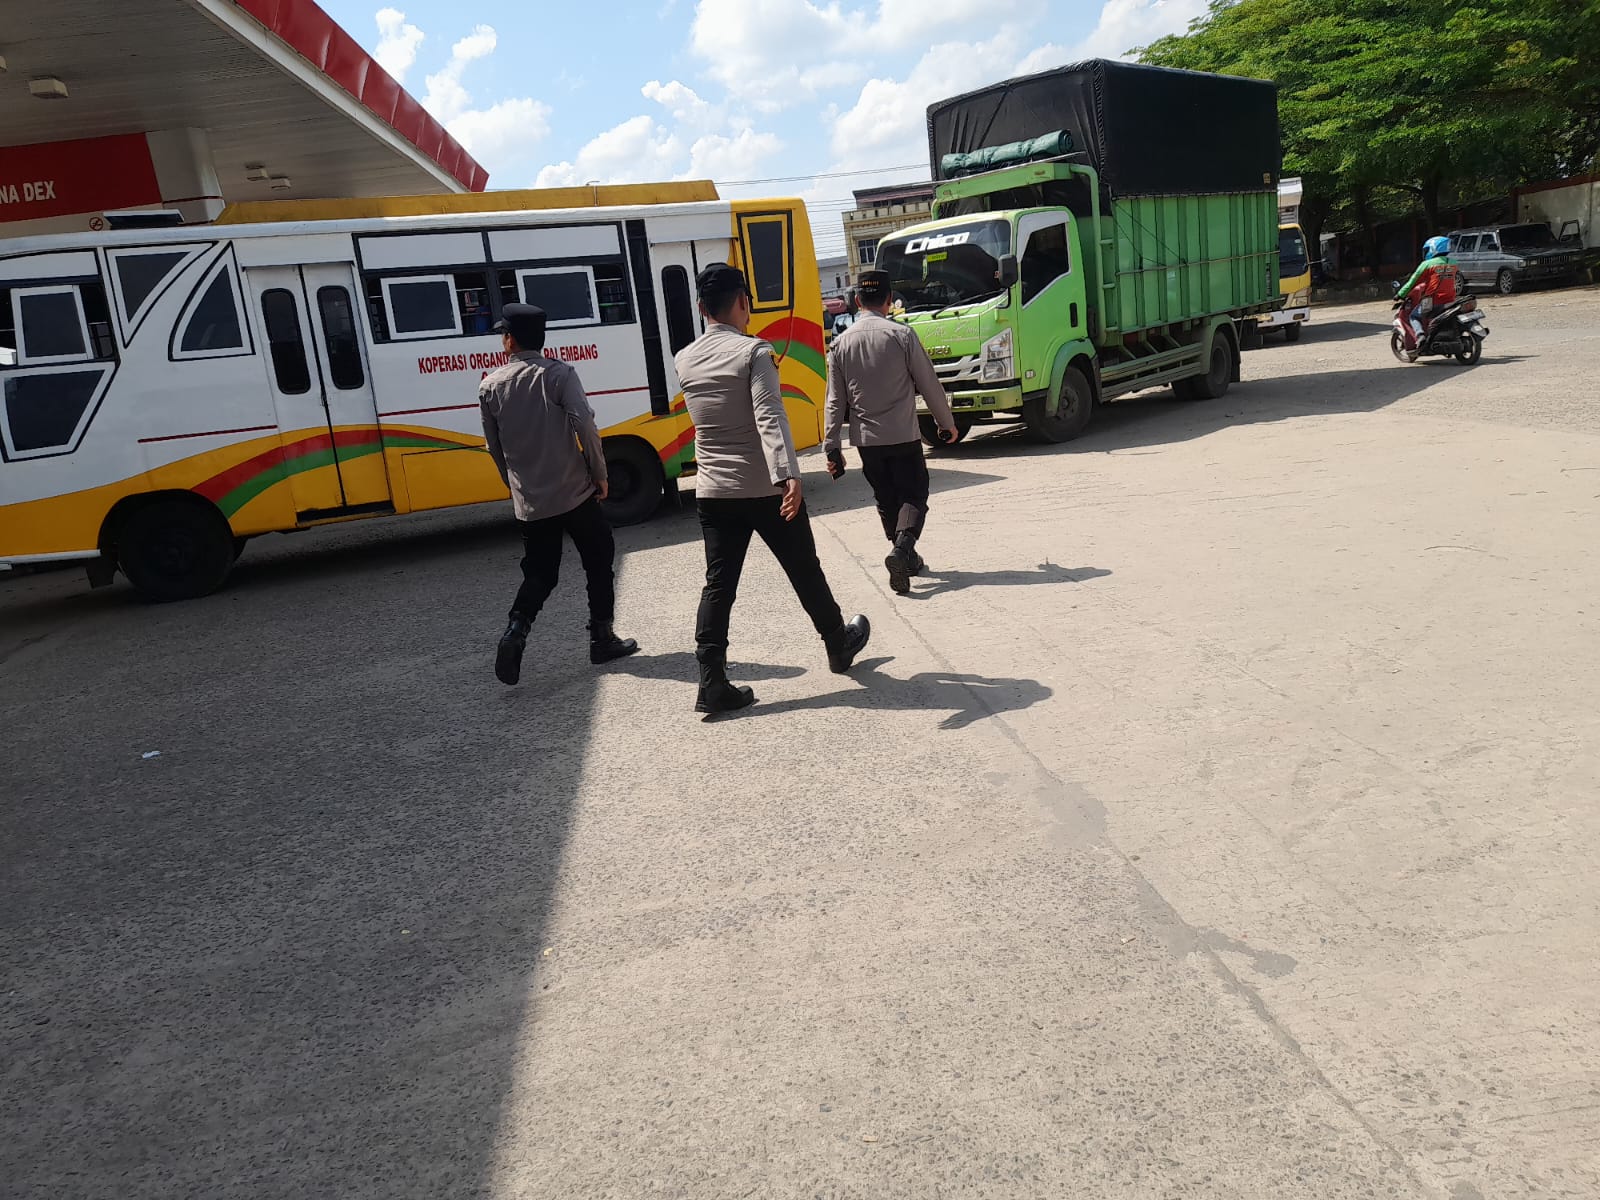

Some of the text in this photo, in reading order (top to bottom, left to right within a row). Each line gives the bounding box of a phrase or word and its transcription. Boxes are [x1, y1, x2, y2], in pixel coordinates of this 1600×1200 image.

[23, 180, 56, 202] DEX
[417, 353, 467, 374] KOPERASI
[470, 351, 511, 370] ORGAND
